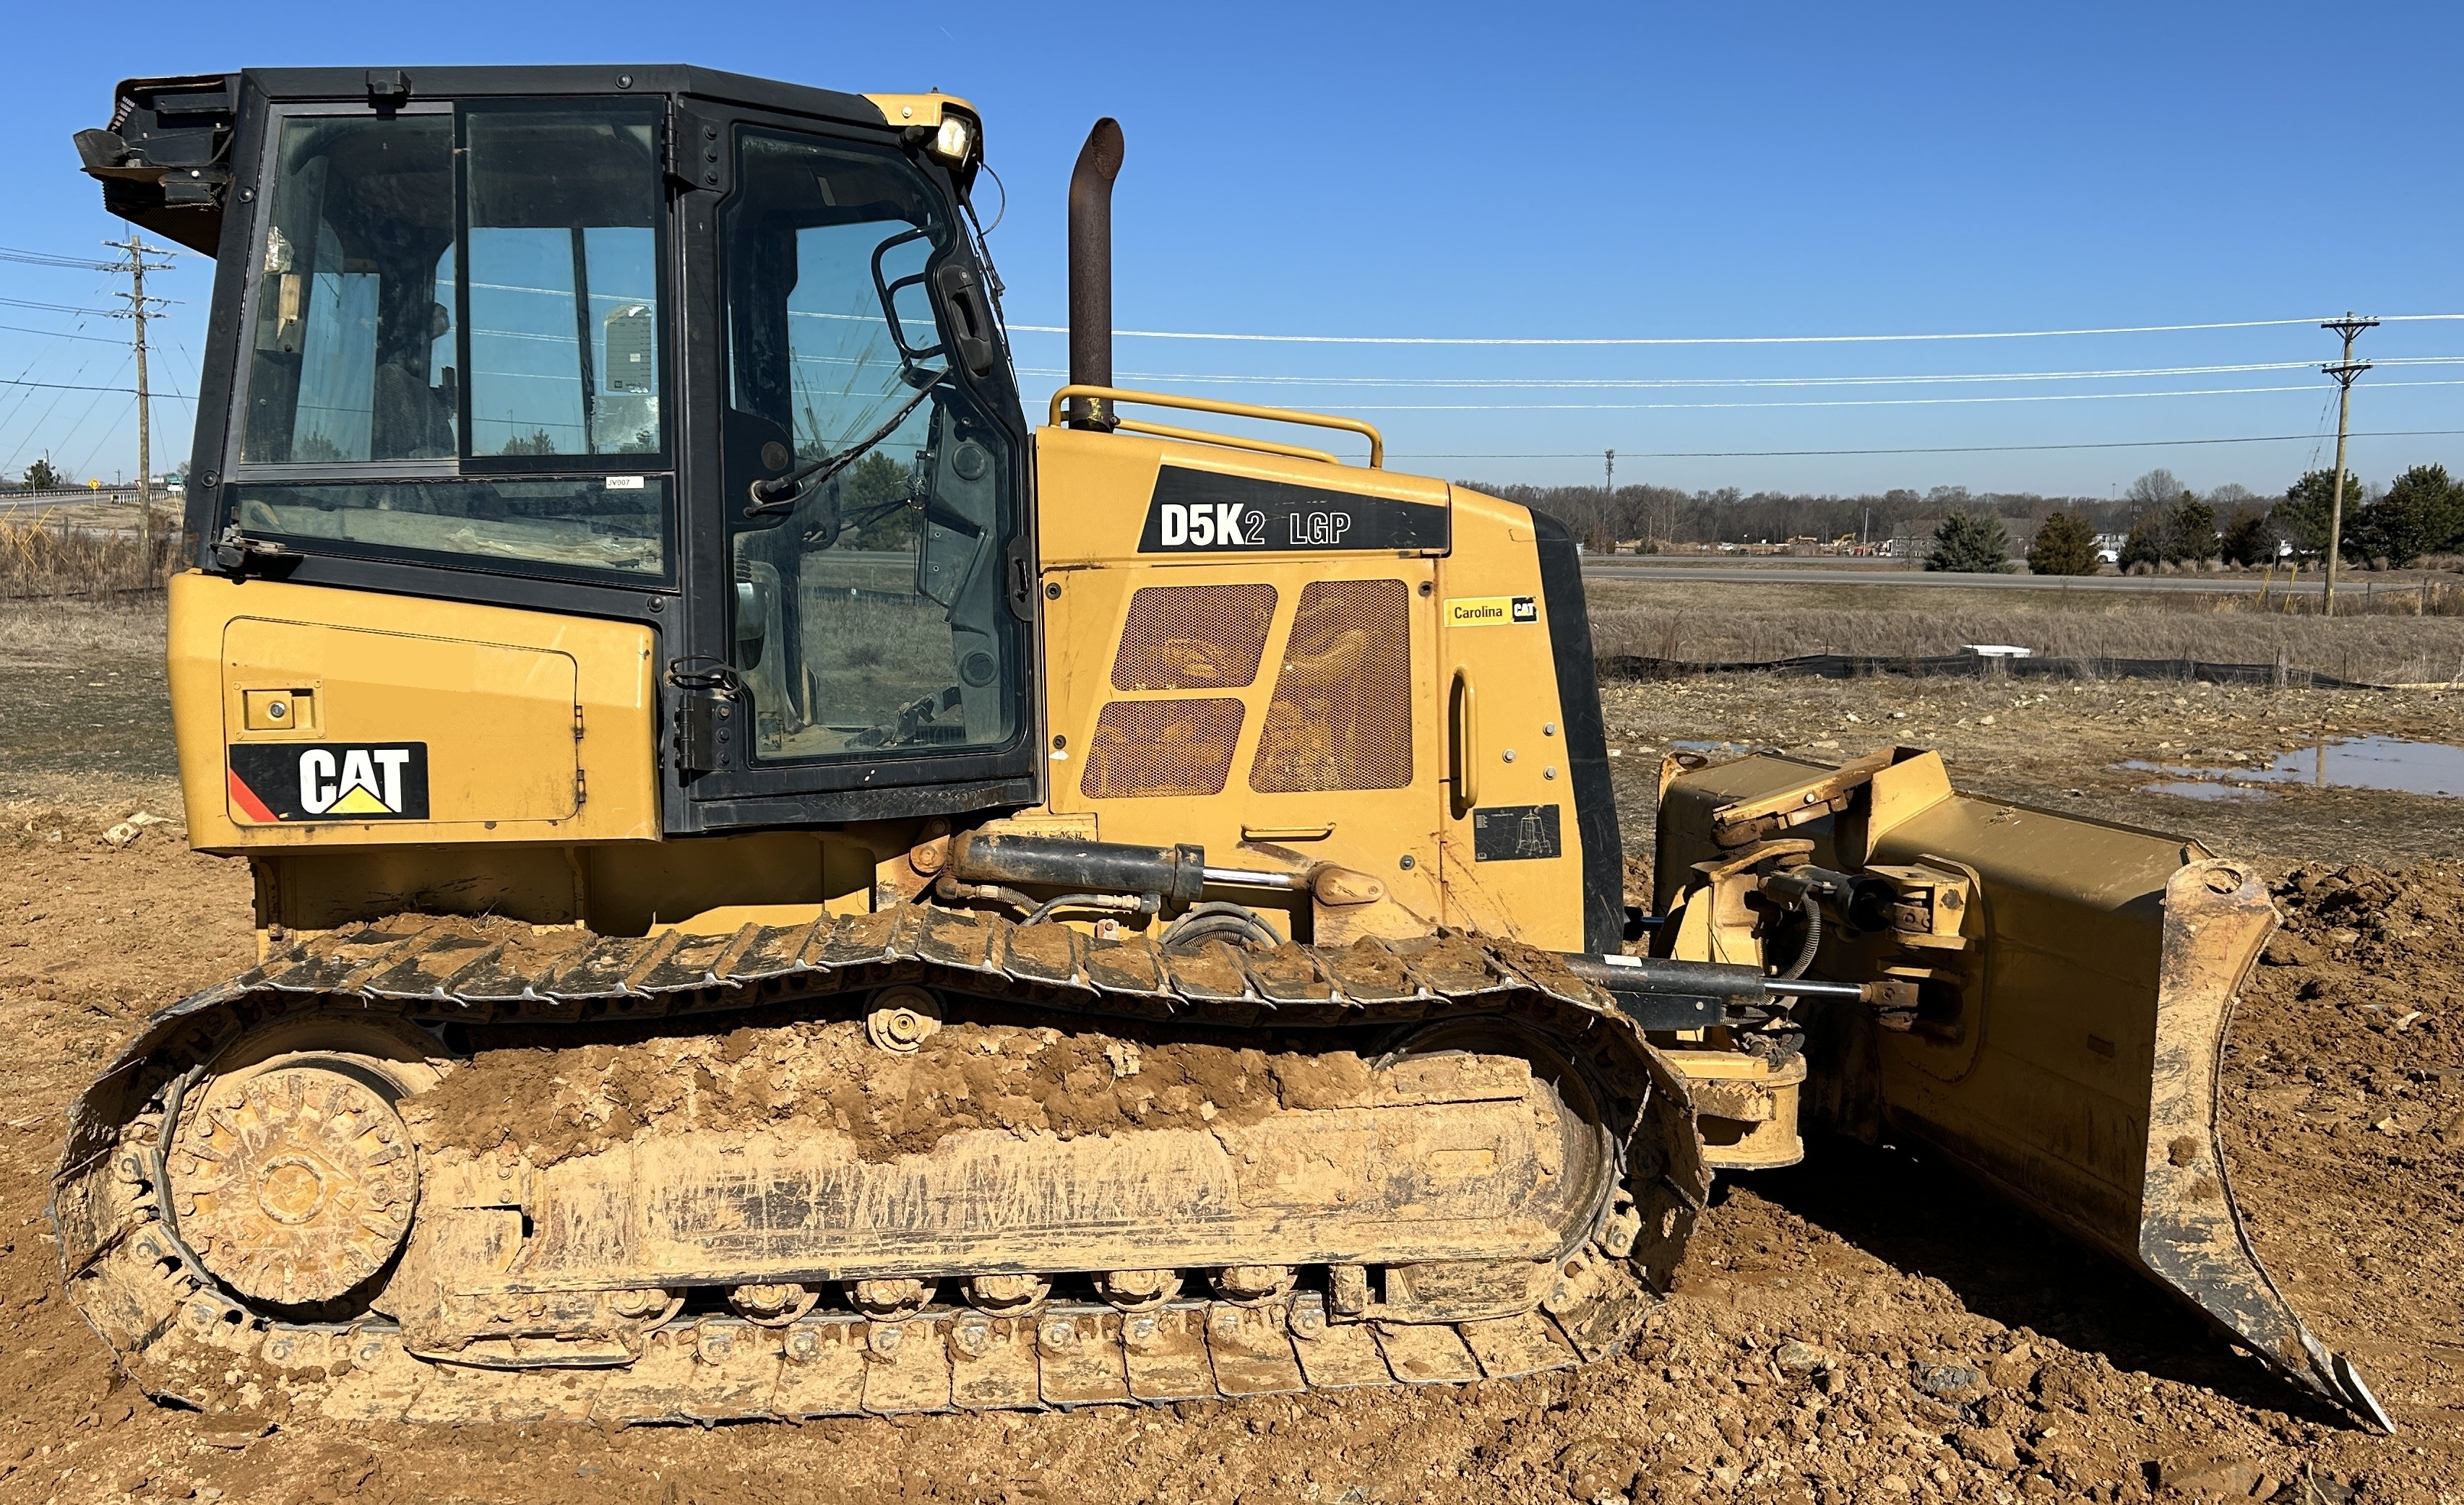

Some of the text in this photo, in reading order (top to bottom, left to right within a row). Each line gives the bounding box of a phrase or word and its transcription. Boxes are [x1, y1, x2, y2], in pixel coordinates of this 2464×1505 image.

[1290, 512, 1351, 545] LGP
[1455, 603, 1535, 618] Carolina CAT
[299, 749, 410, 814] CAT
